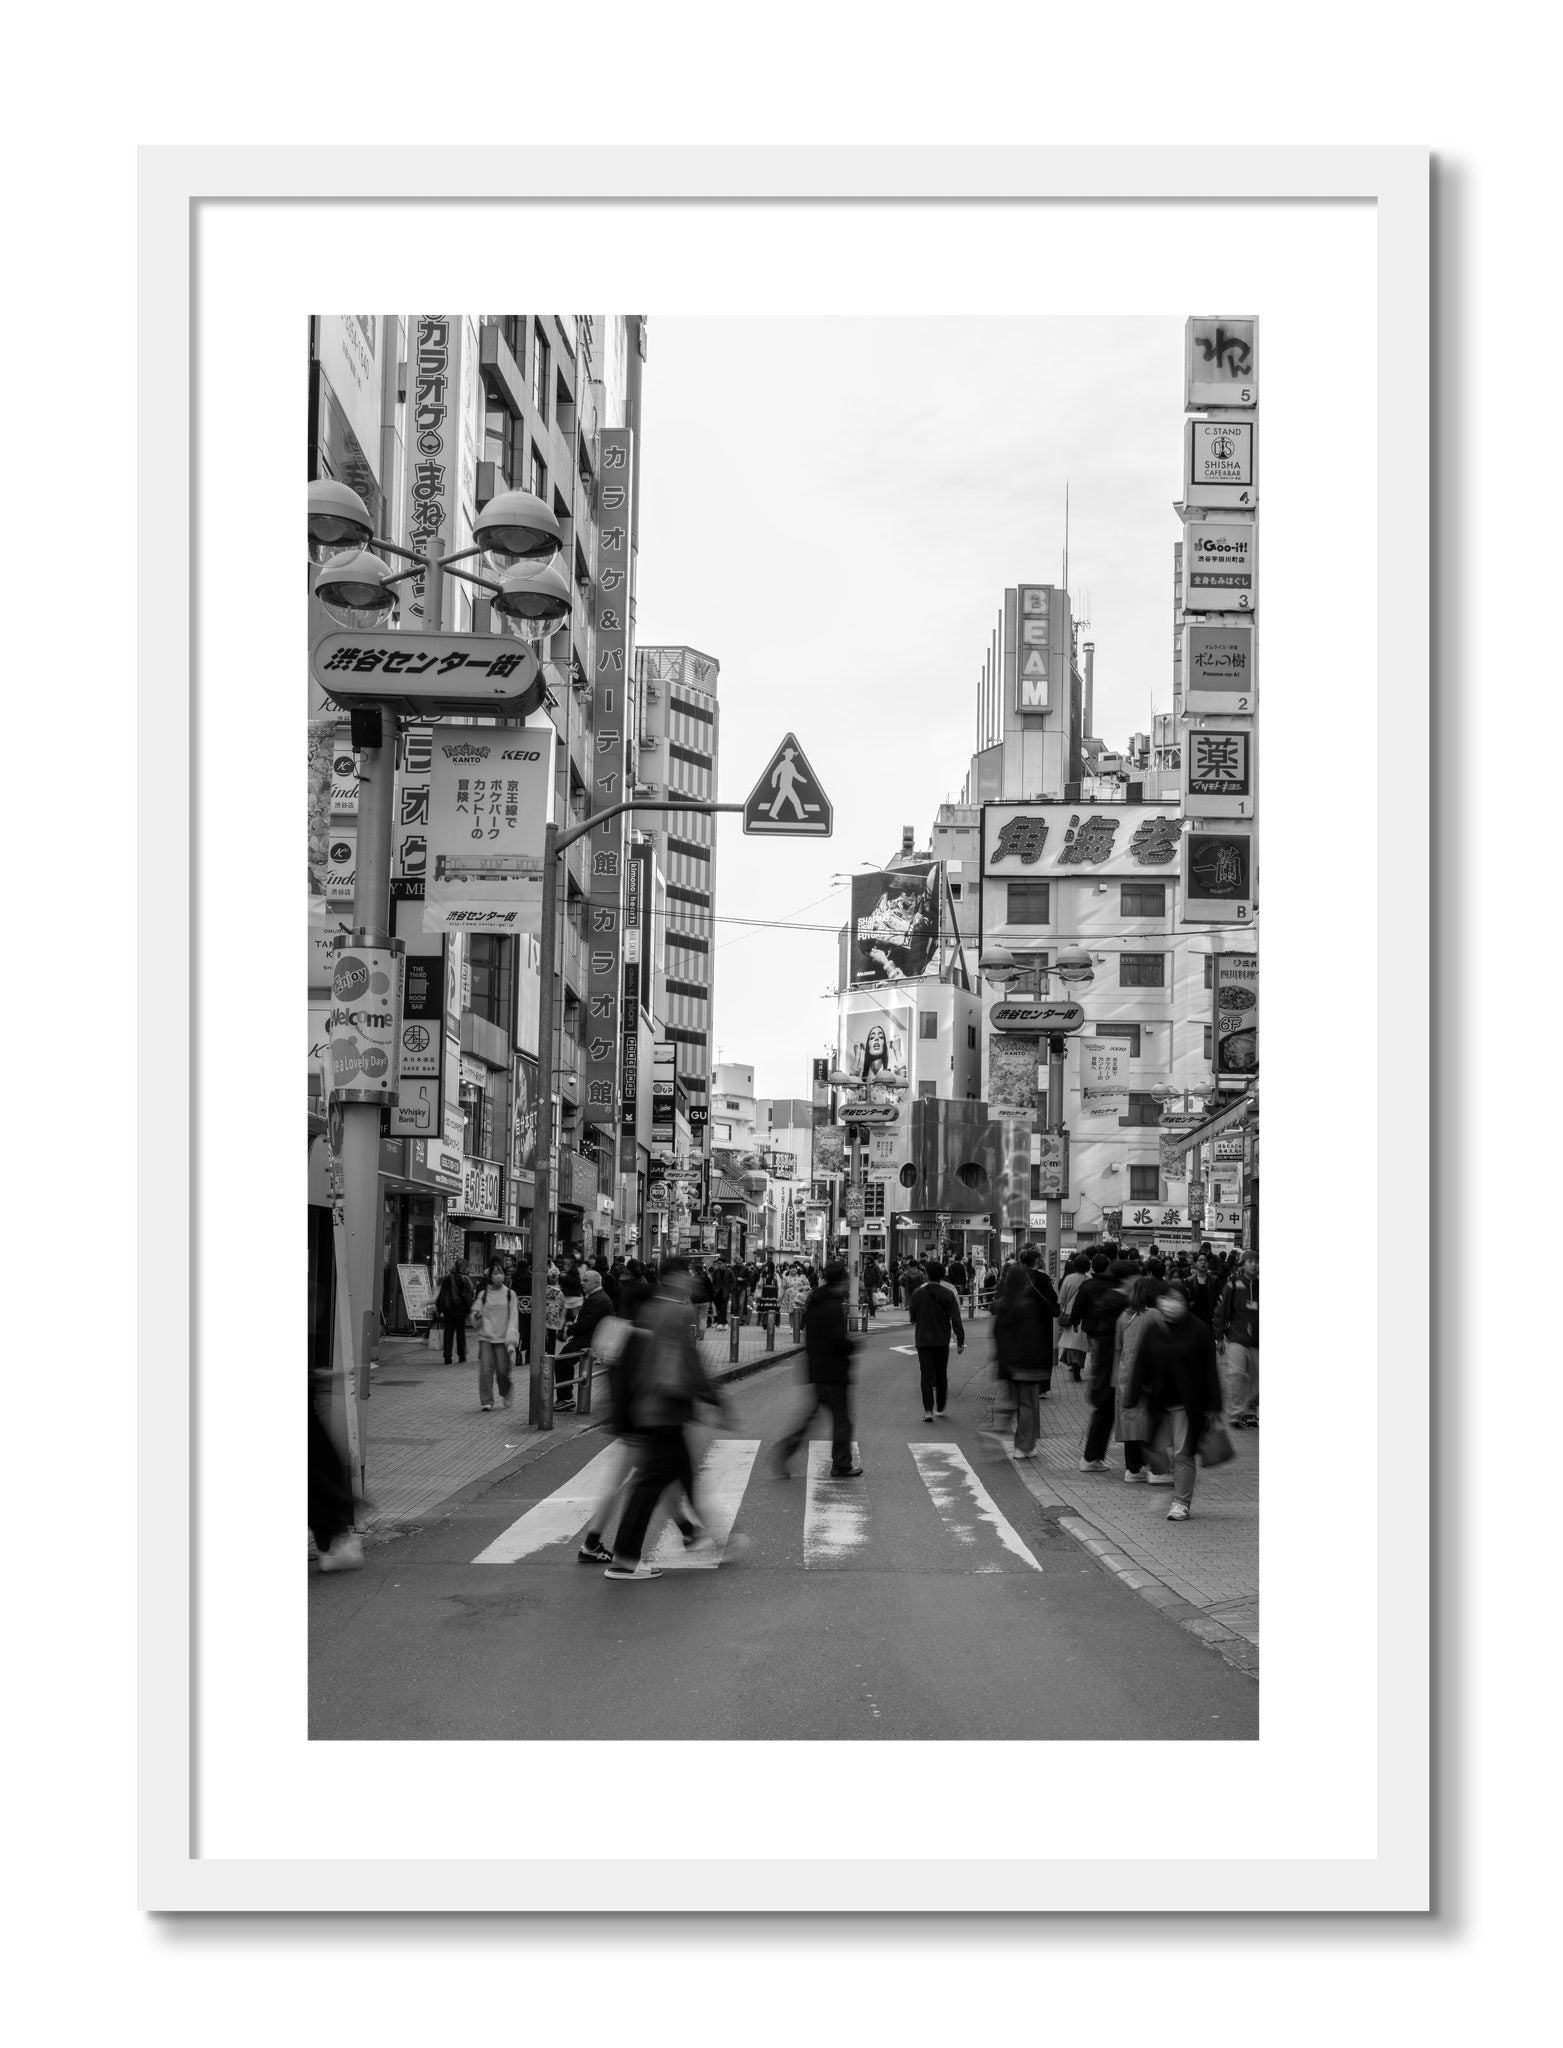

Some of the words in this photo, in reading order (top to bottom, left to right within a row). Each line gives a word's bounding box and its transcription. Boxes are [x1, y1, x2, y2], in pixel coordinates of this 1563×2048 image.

[416, 320, 448, 433] カラオケ
[1241, 389, 1251, 402] 5
[1205, 427, 1241, 436] C.STAND
[1205, 461, 1241, 469] SHISHA
[1240, 491, 1250, 505] 4
[1203, 539, 1248, 553] Goo-it!
[1193, 576, 1249, 586] 全身もみほぐし
[1238, 594, 1249, 608] 3
[1021, 588, 1049, 707] BEAM
[324, 647, 525, 678] 渋谷センター街
[1238, 697, 1249, 710] 2
[501, 750, 541, 762] KEIO
[1197, 736, 1238, 778] 薬
[456, 779, 470, 814] 冒険へ
[471, 779, 486, 840] カントーの
[505, 780, 519, 829] 京王線で
[1238, 801, 1245, 814] 1
[990, 814, 1186, 864] 角海老
[629, 863, 638, 892] kimono
[446, 911, 518, 921] 渋谷センター街
[1237, 905, 1246, 918] B
[335, 967, 367, 995] Enjoy
[588, 909, 617, 1106] カラオケ館
[996, 1009, 1079, 1020] 渋谷センター街
[332, 1008, 393, 1028] Welcome
[1220, 1016, 1242, 1032] 6F
[345, 1056, 370, 1071] Lovely
[399, 1108, 426, 1118] Whisky
[690, 1111, 708, 1120] GU
[380, 1125, 389, 1133] 1F
[1133, 1207, 1182, 1225] 兆楽
[786, 1206, 794, 1241] BEER
